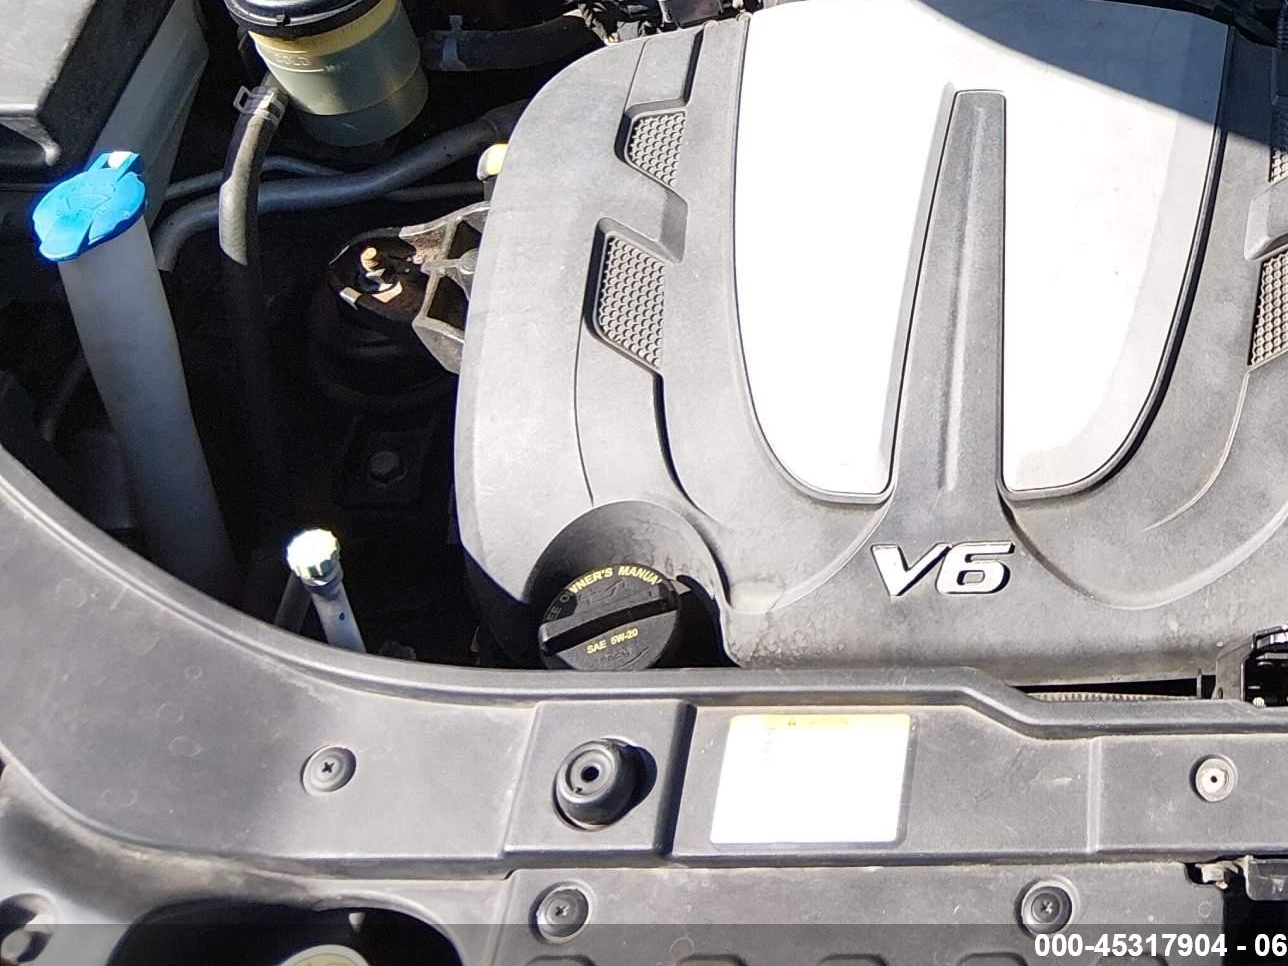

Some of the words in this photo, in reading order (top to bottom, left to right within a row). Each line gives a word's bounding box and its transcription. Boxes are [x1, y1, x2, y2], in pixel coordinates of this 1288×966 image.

[547, 605, 562, 621] EE
[560, 567, 613, 603] OWNER'S
[870, 541, 1016, 597] V6
[586, 640, 607, 654] SAE
[610, 628, 638, 645] 5W-20
